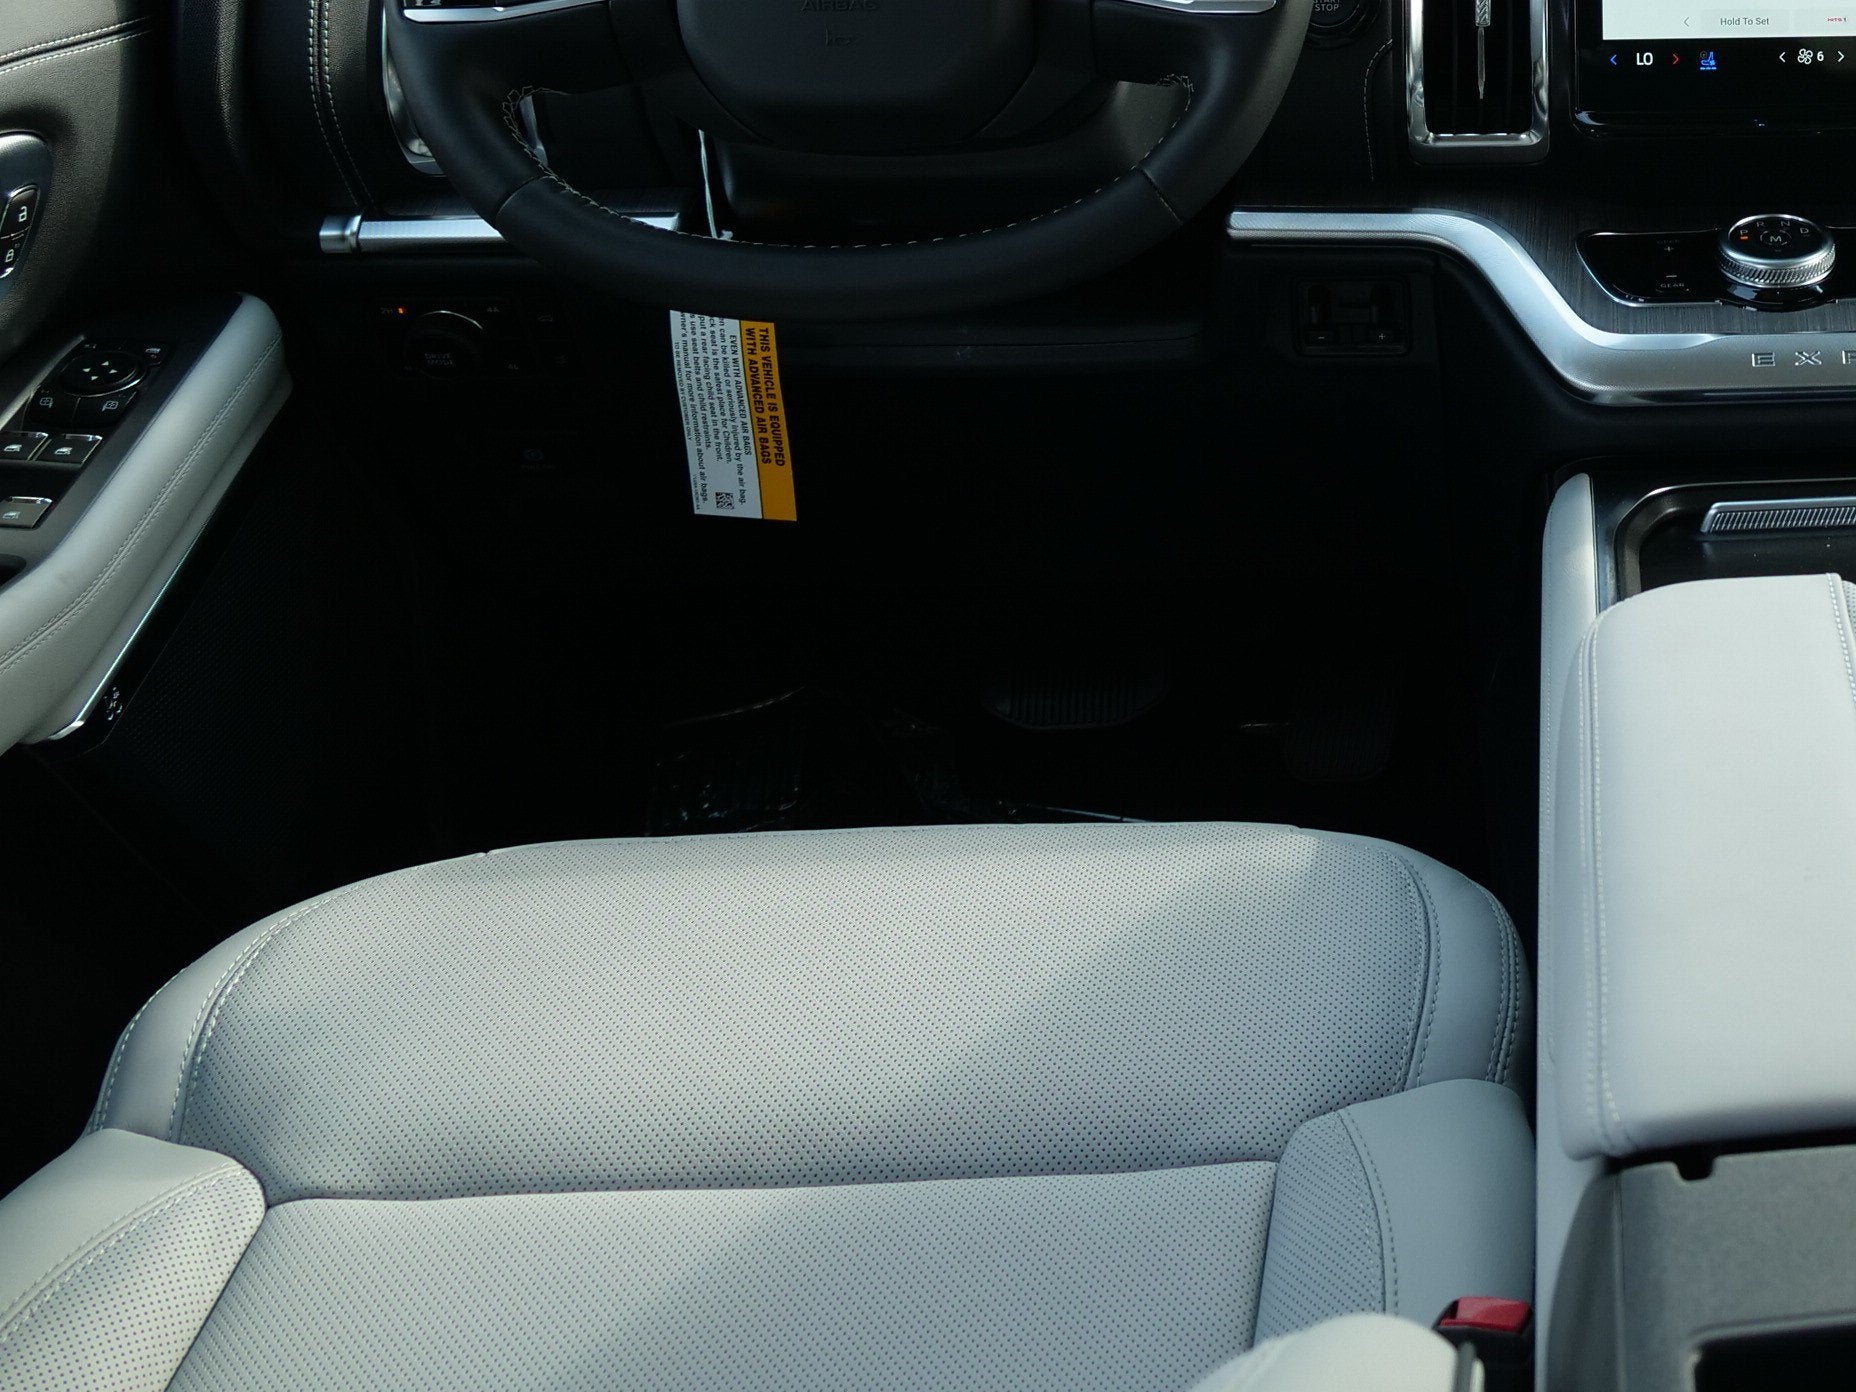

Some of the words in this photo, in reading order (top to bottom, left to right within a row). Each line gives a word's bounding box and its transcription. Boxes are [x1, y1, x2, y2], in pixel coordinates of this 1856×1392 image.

[801, 0, 880, 12] AIRBAG
[1314, 3, 1340, 12] STOP
[1719, 17, 1738, 26] Hold
[1740, 17, 1750, 26] To
[1753, 17, 1770, 26] Set
[1636, 52, 1654, 66] LO
[1816, 51, 1825, 62] 6
[701, 338, 709, 355] rear
[721, 345, 728, 355] be
[730, 335, 738, 356] EVEN
[746, 328, 757, 356] WITH
[759, 328, 770, 353] THIS
[682, 340, 692, 369] manual
[692, 338, 700, 355] seat
[697, 377, 705, 392] and
[703, 356, 712, 381] facing
[722, 358, 731, 378] killed
[732, 358, 740, 378] WITH
[686, 370, 695, 382] for
[761, 356, 776, 400] VEHICLE
[687, 383, 696, 403] more
[748, 359, 765, 414] ADVANCED
[717, 396, 727, 418] place
[734, 380, 747, 419] ADVANCED
[768, 403, 778, 412] IS
[690, 404, 702, 447] information
[712, 419, 718, 427] in
[721, 419, 730, 430] for
[740, 421, 749, 434] AIR
[756, 417, 767, 434] AIR
[723, 431, 732, 465] Children.
[731, 425, 742, 451] injured
[743, 436, 751, 456] BAGS
[770, 416, 785, 467] EQUIPPED
[697, 448, 706, 470] about
[714, 442, 723, 462] front.
[735, 453, 742, 462] by
[758, 438, 771, 465] BAGS
[699, 471, 707, 482] air
[700, 483, 710, 504] bags.
